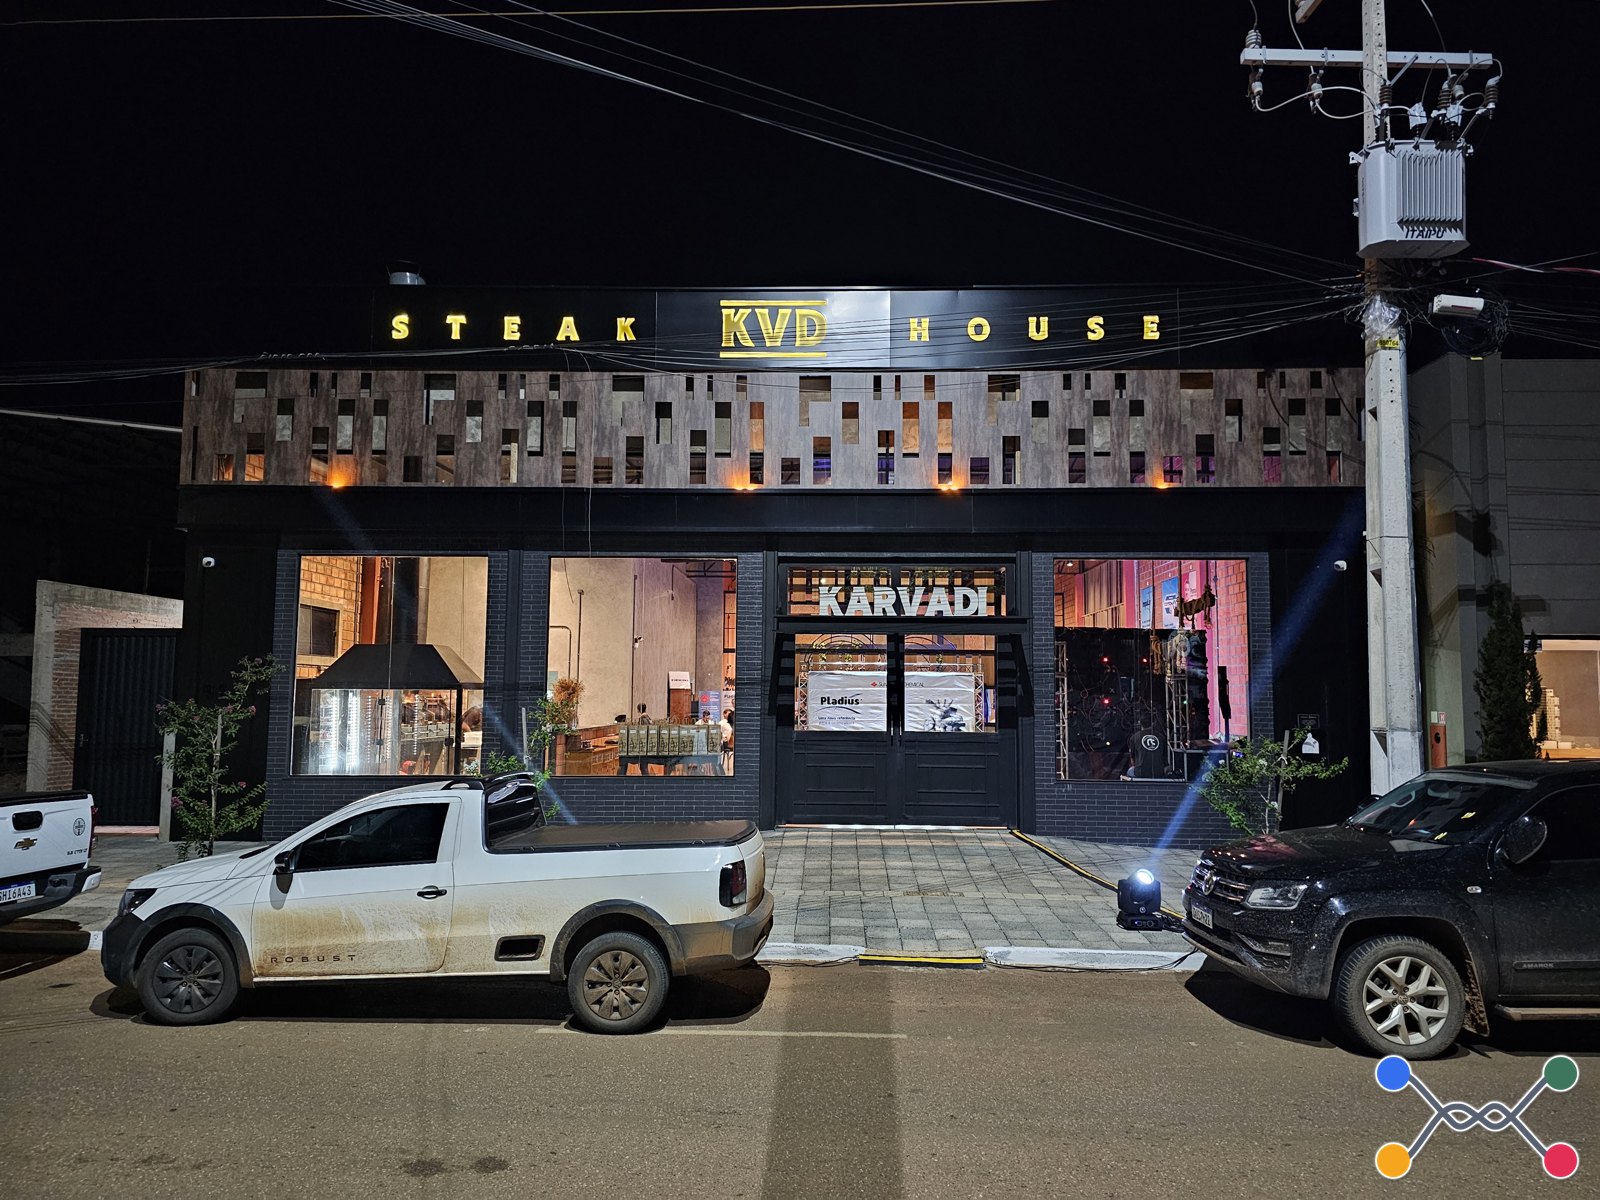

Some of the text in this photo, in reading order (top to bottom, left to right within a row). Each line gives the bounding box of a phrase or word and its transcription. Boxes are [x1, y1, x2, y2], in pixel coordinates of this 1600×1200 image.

[1405, 229, 1445, 239] ITAIPU
[391, 308, 1160, 347] STEAK KVD HOUSE
[818, 586, 989, 617] KARVADI
[820, 696, 860, 705] Pladius
[270, 955, 356, 963] ROBUST
